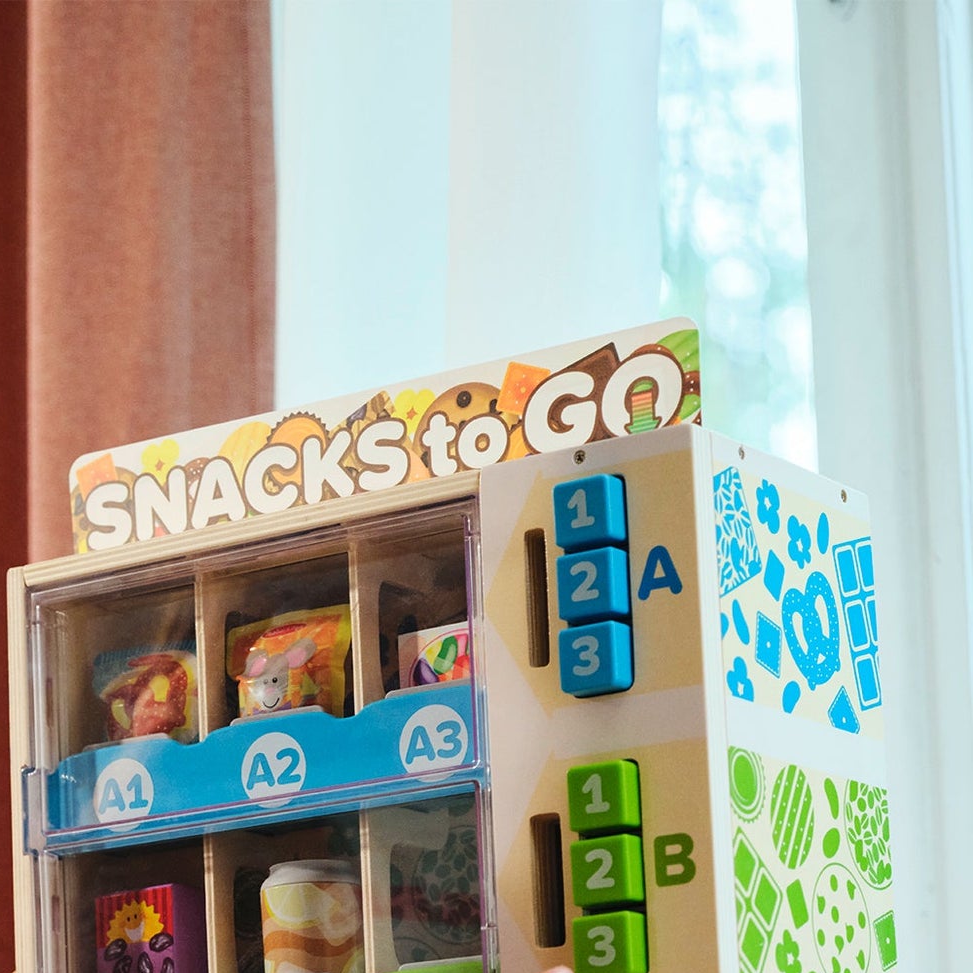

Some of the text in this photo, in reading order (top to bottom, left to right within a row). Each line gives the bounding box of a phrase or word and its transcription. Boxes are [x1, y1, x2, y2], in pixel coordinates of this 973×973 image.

[85, 352, 683, 552] SNACKS to GO
[566, 489, 595, 529] 1
[570, 561, 599, 602] 2
[638, 545, 683, 601] A
[572, 636, 600, 676] 3
[405, 720, 463, 765] A3
[246, 747, 302, 791] A2
[98, 774, 149, 815] A1
[581, 773, 610, 814] 1
[585, 849, 615, 890] 2
[654, 832, 696, 887] B
[586, 925, 615, 967] 3
